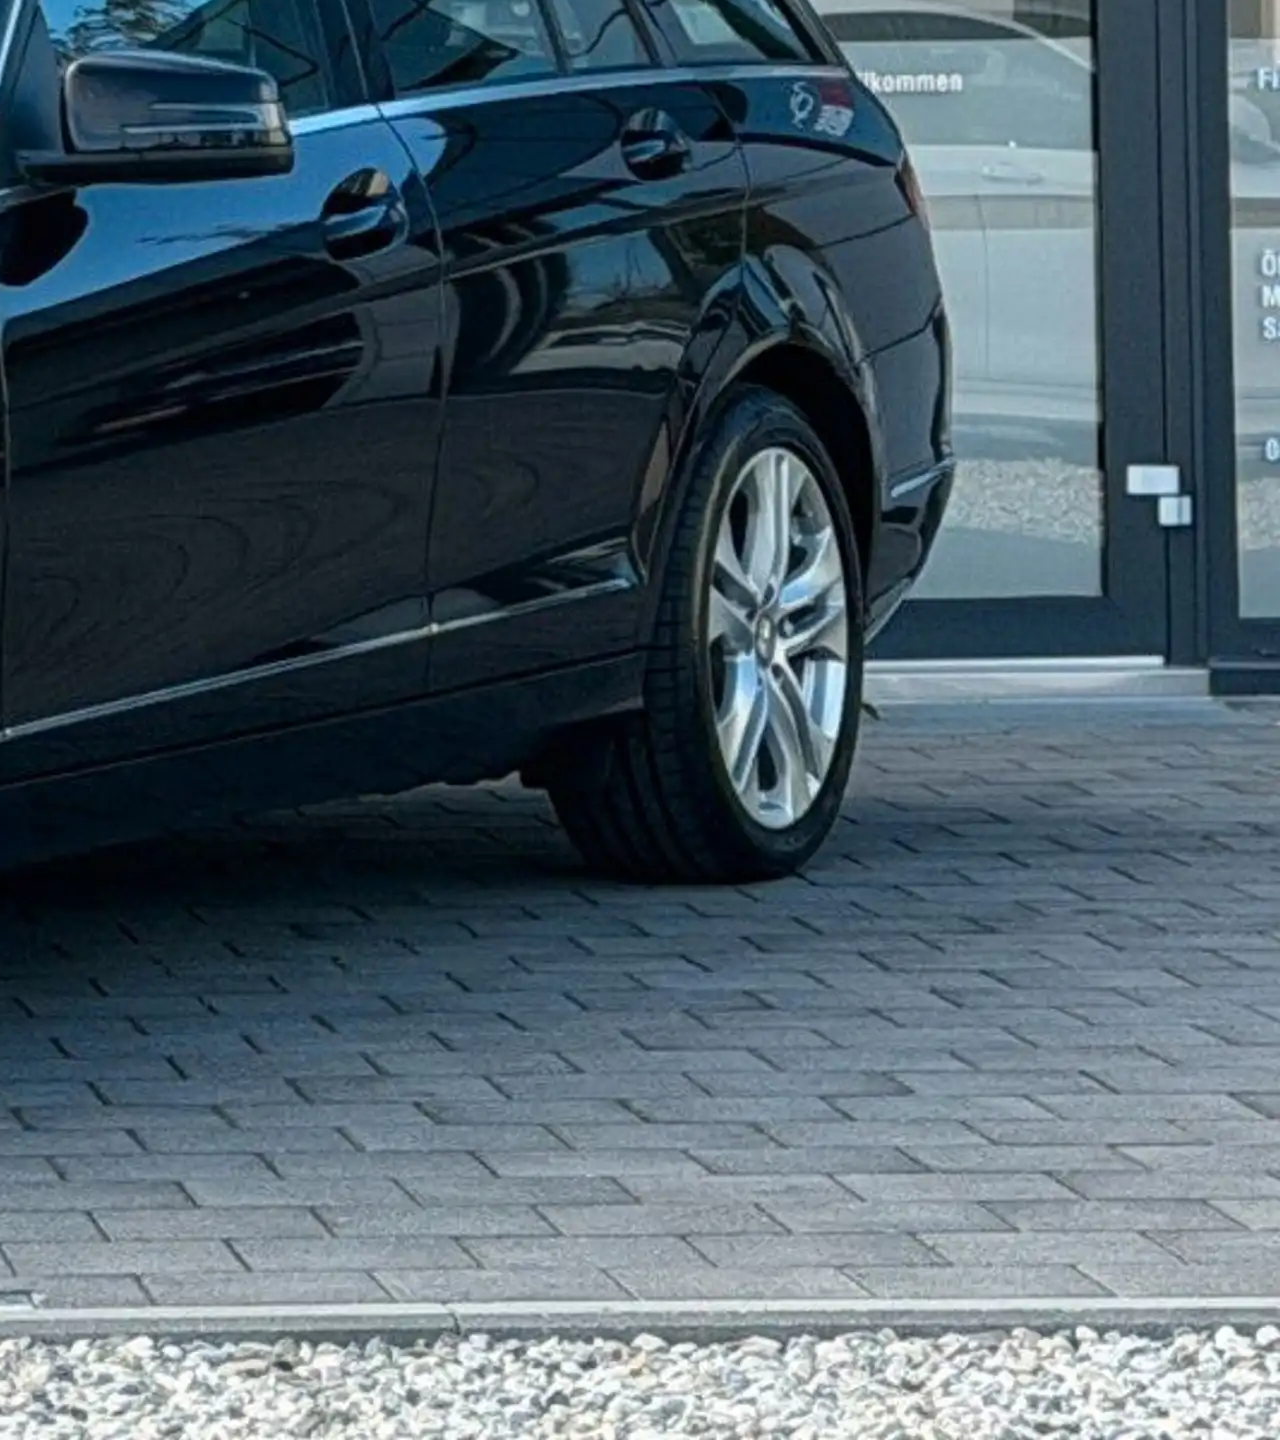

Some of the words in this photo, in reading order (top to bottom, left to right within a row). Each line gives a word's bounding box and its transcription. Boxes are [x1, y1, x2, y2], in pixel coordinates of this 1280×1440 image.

[856, 70, 963, 93] lkommen
[1261, 248, 1280, 277] Ö
[1262, 316, 1280, 340] S
